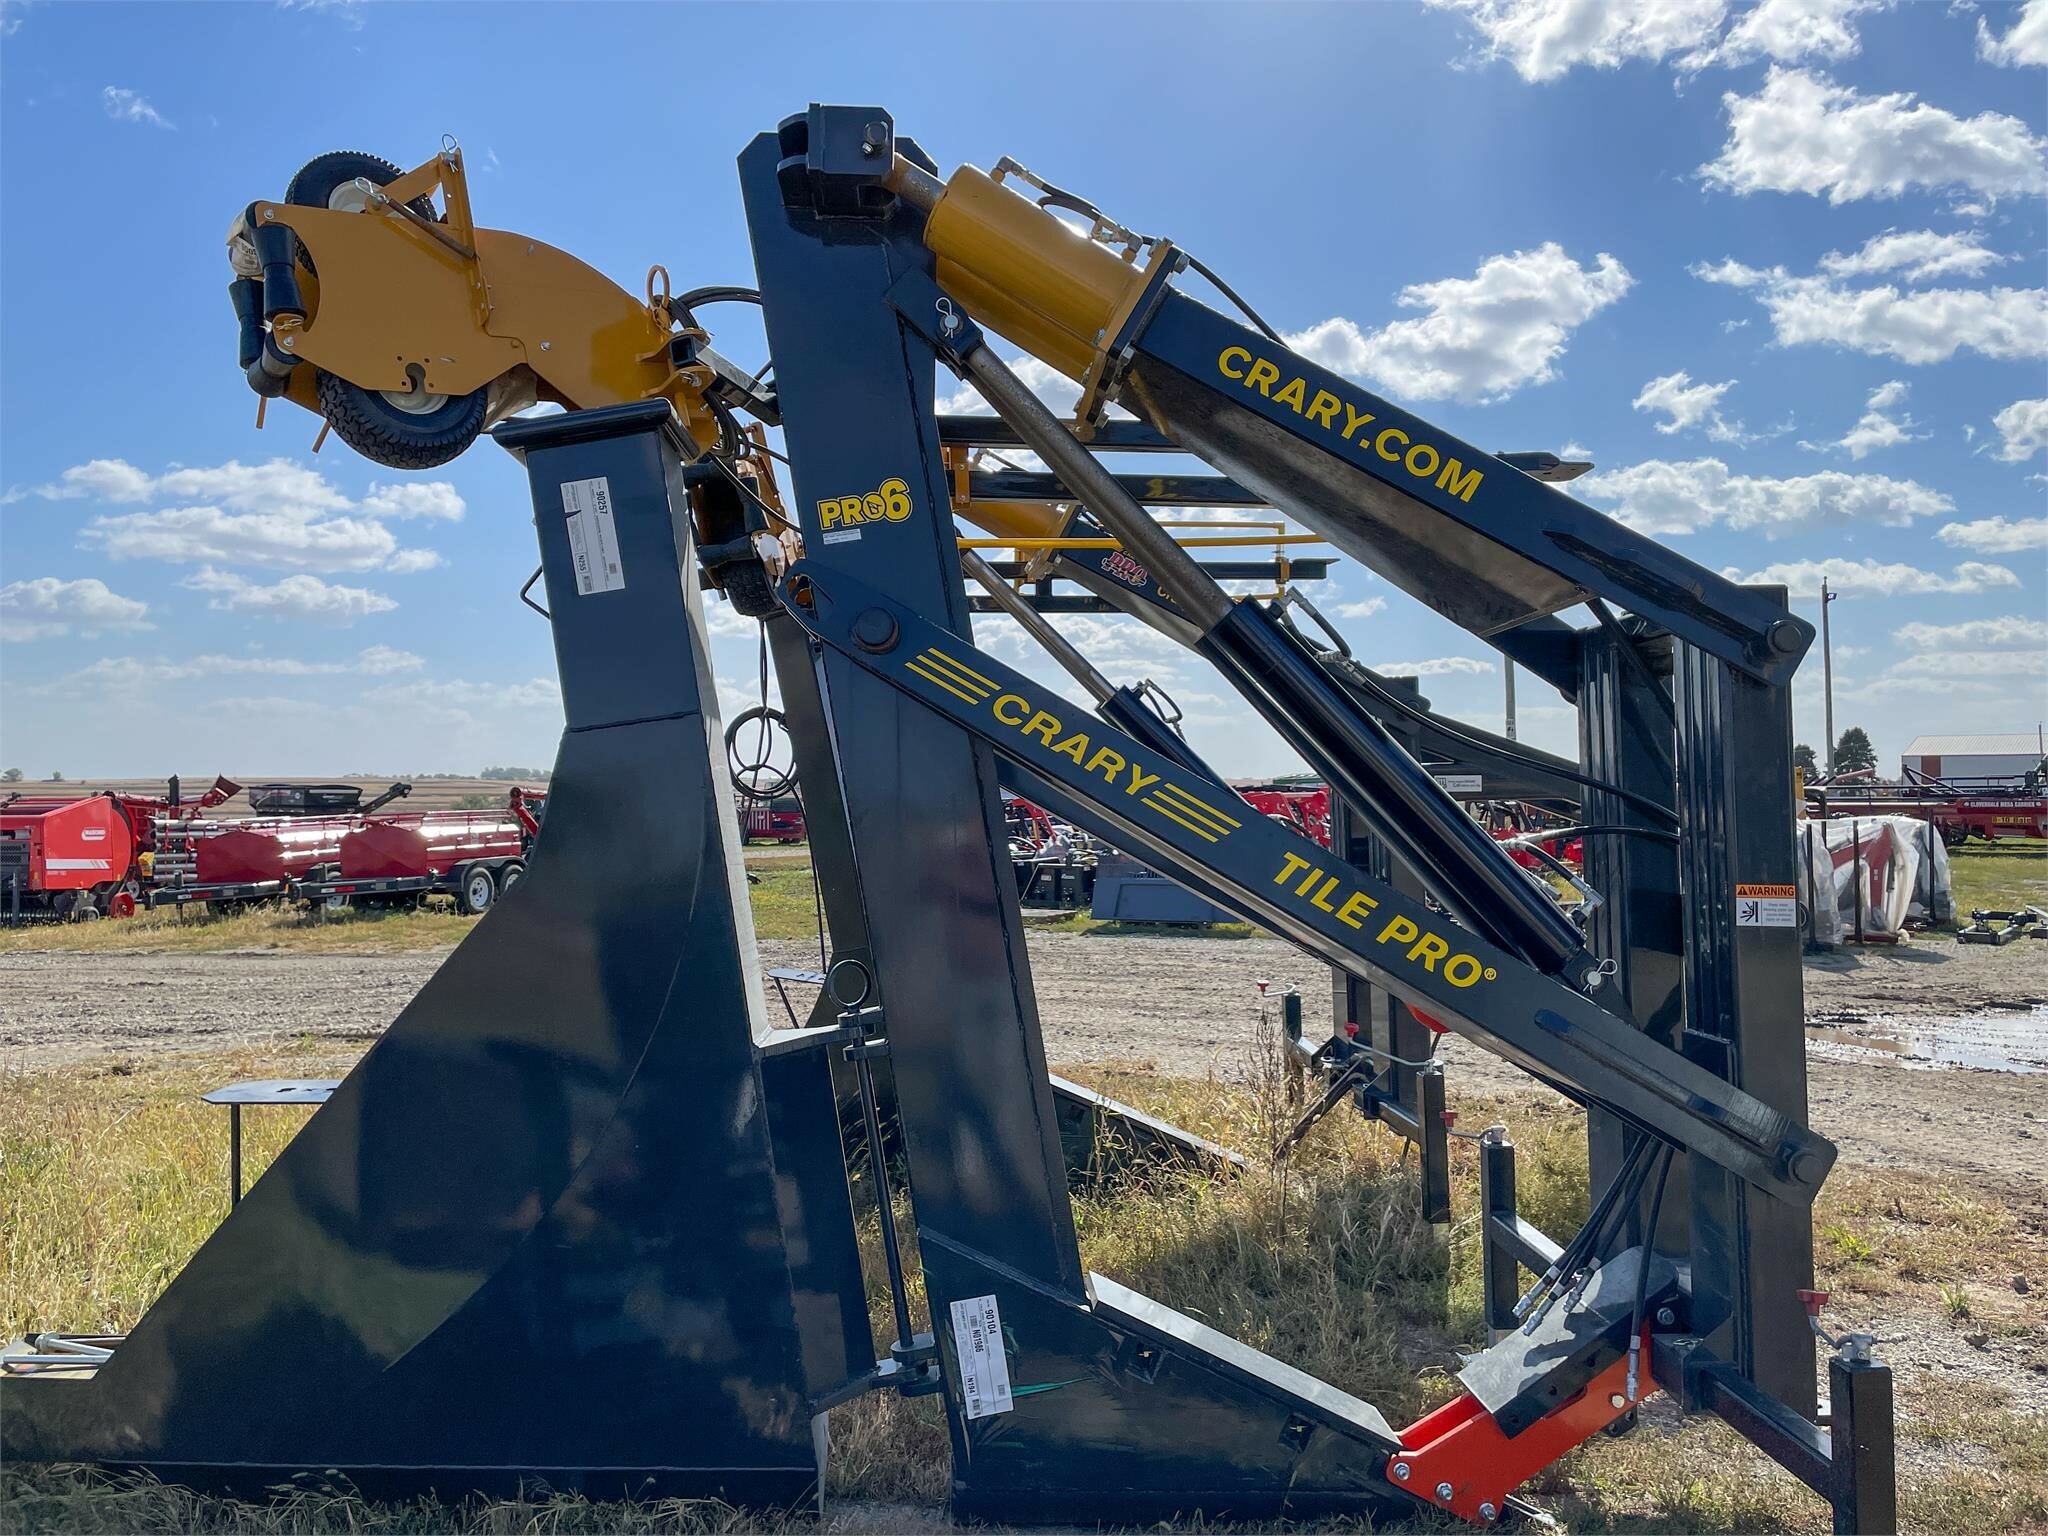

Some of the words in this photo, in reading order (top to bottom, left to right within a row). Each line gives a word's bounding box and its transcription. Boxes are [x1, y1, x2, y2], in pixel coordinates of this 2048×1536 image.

[1218, 346, 1485, 503] CRARY.COM
[596, 490, 608, 515] 90257
[992, 694, 1162, 795] CRARY
[1273, 851, 1379, 930] TILE
[1748, 886, 1795, 896] WARNING
[985, 1309, 997, 1334] 90104
